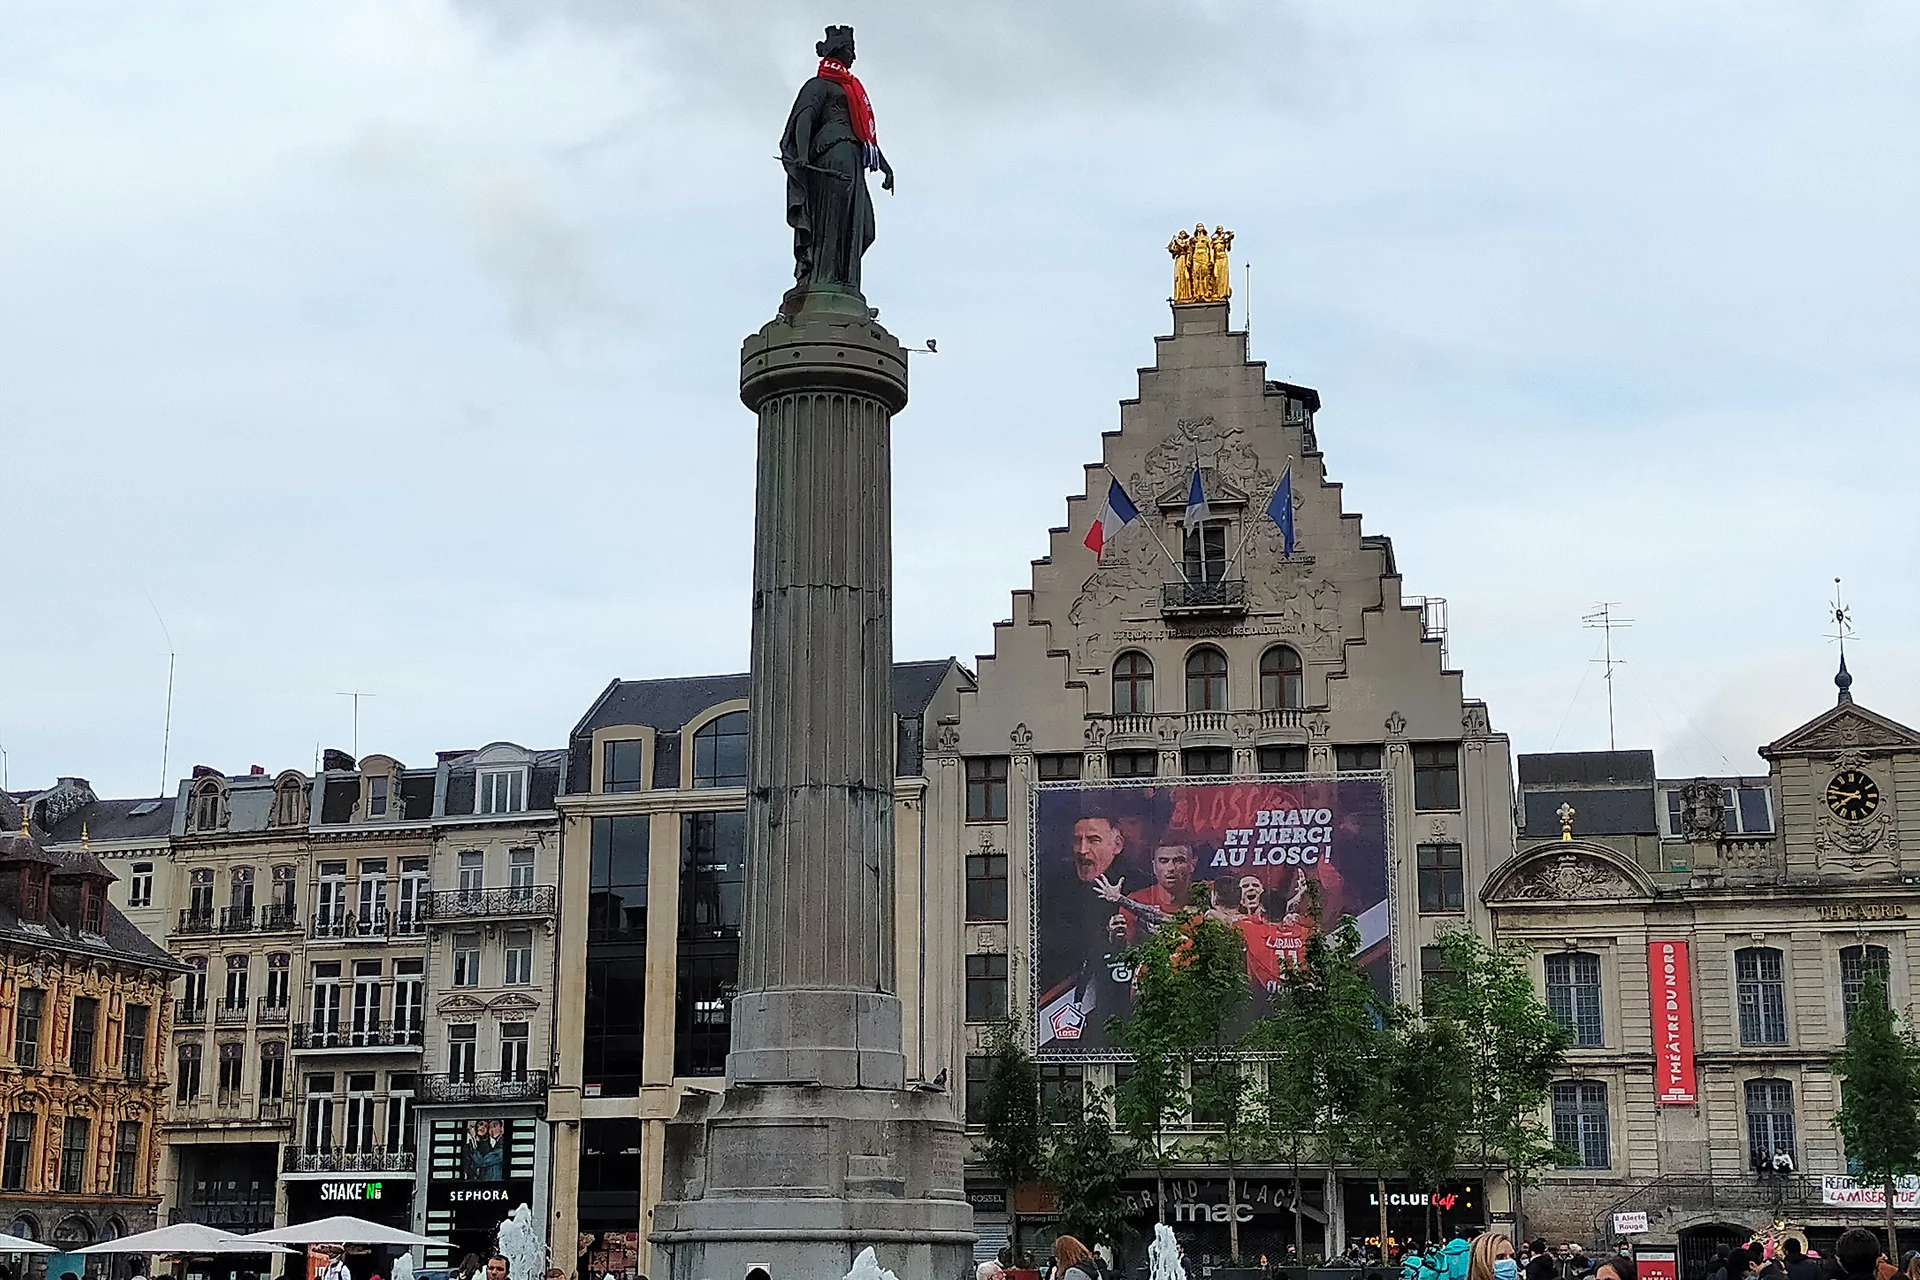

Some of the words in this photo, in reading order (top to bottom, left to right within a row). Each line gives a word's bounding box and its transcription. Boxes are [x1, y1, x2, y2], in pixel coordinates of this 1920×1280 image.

[1255, 808, 1332, 827] BRAVO
[1224, 829, 1253, 846] ET
[1257, 826, 1333, 845] MERCI
[1210, 847, 1248, 867] AU
[1252, 846, 1319, 866] LOSC
[1324, 845, 1332, 864] !
[1663, 943, 1676, 986] NORD
[1666, 989, 1678, 1010] DU
[1664, 1013, 1682, 1085] THÉÂTRE
[450, 1190, 509, 1201] SEPHORA
[1390, 1193, 1429, 1206] CLUB
[1830, 1192, 1845, 1201] LA
[1174, 1202, 1254, 1222] fnac
[1619, 1223, 1644, 1231] Rouge
